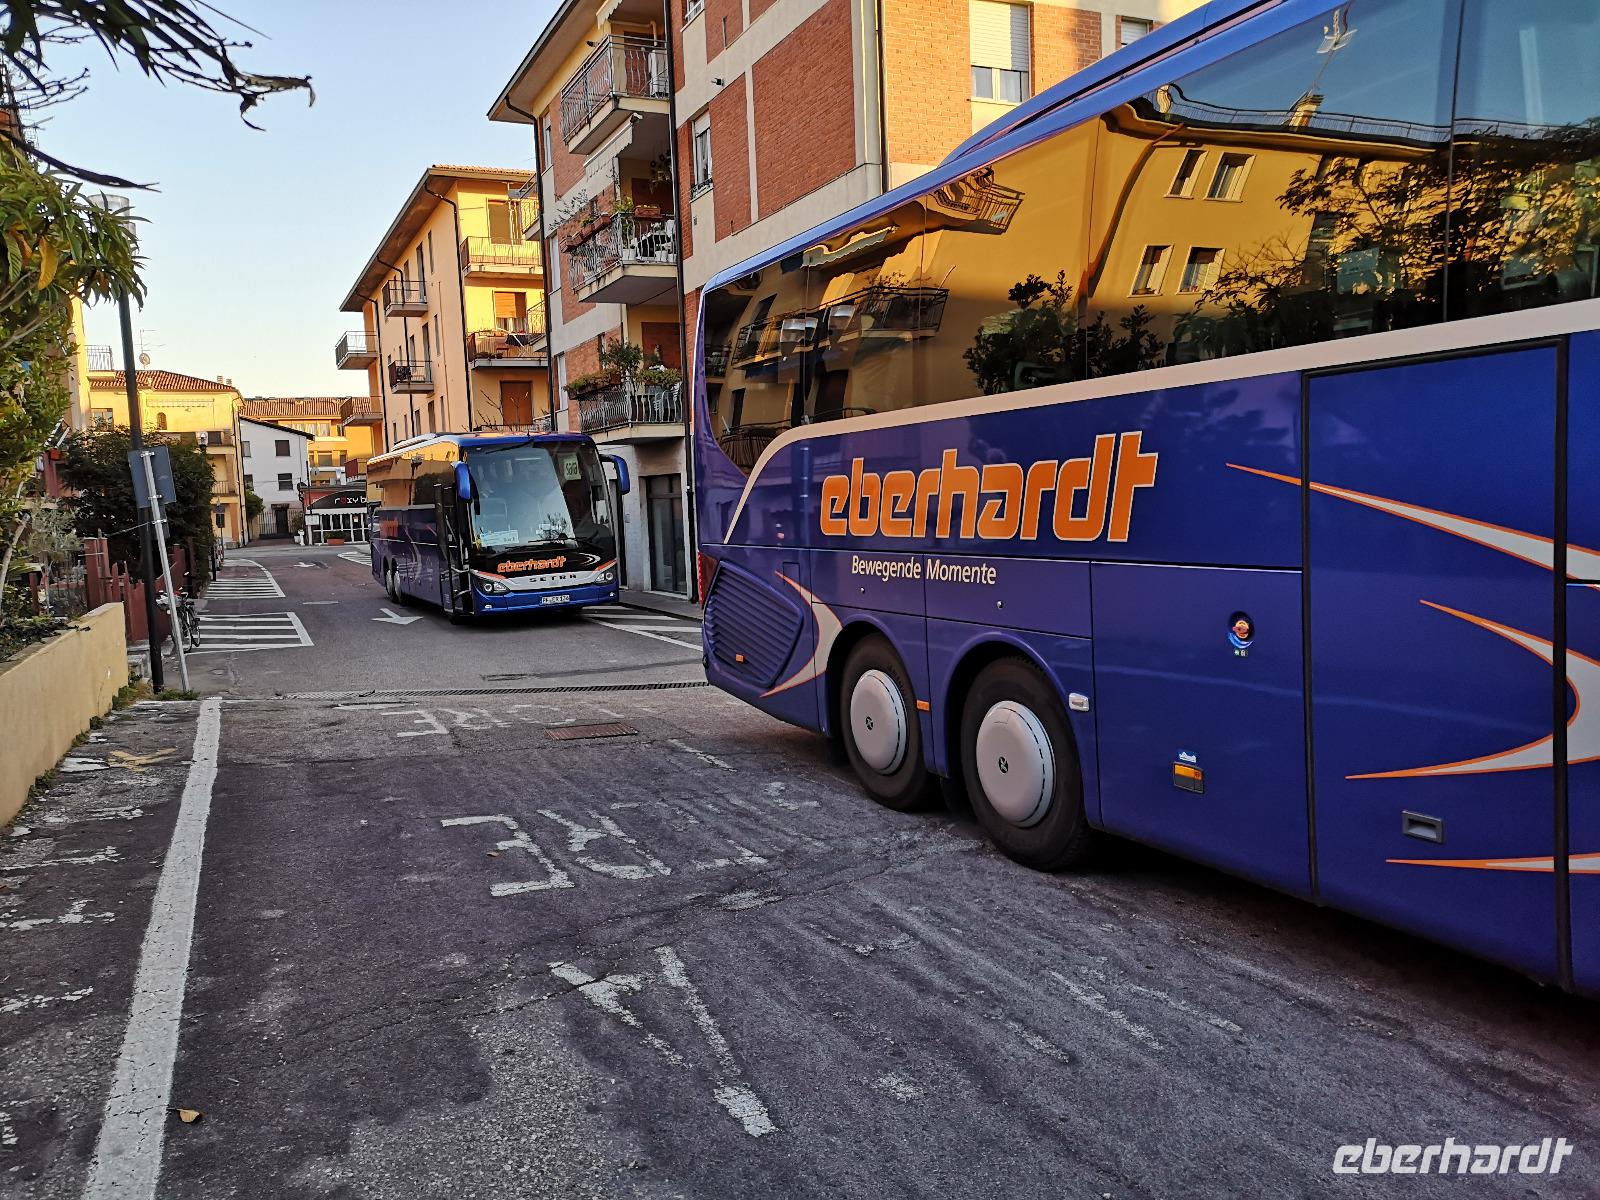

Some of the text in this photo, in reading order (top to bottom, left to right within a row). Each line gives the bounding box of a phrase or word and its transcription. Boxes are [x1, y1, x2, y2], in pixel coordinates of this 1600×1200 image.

[820, 430, 1159, 542] eberhardt
[497, 556, 567, 573] eberhardt
[851, 555, 997, 585] Bewegende Momente
